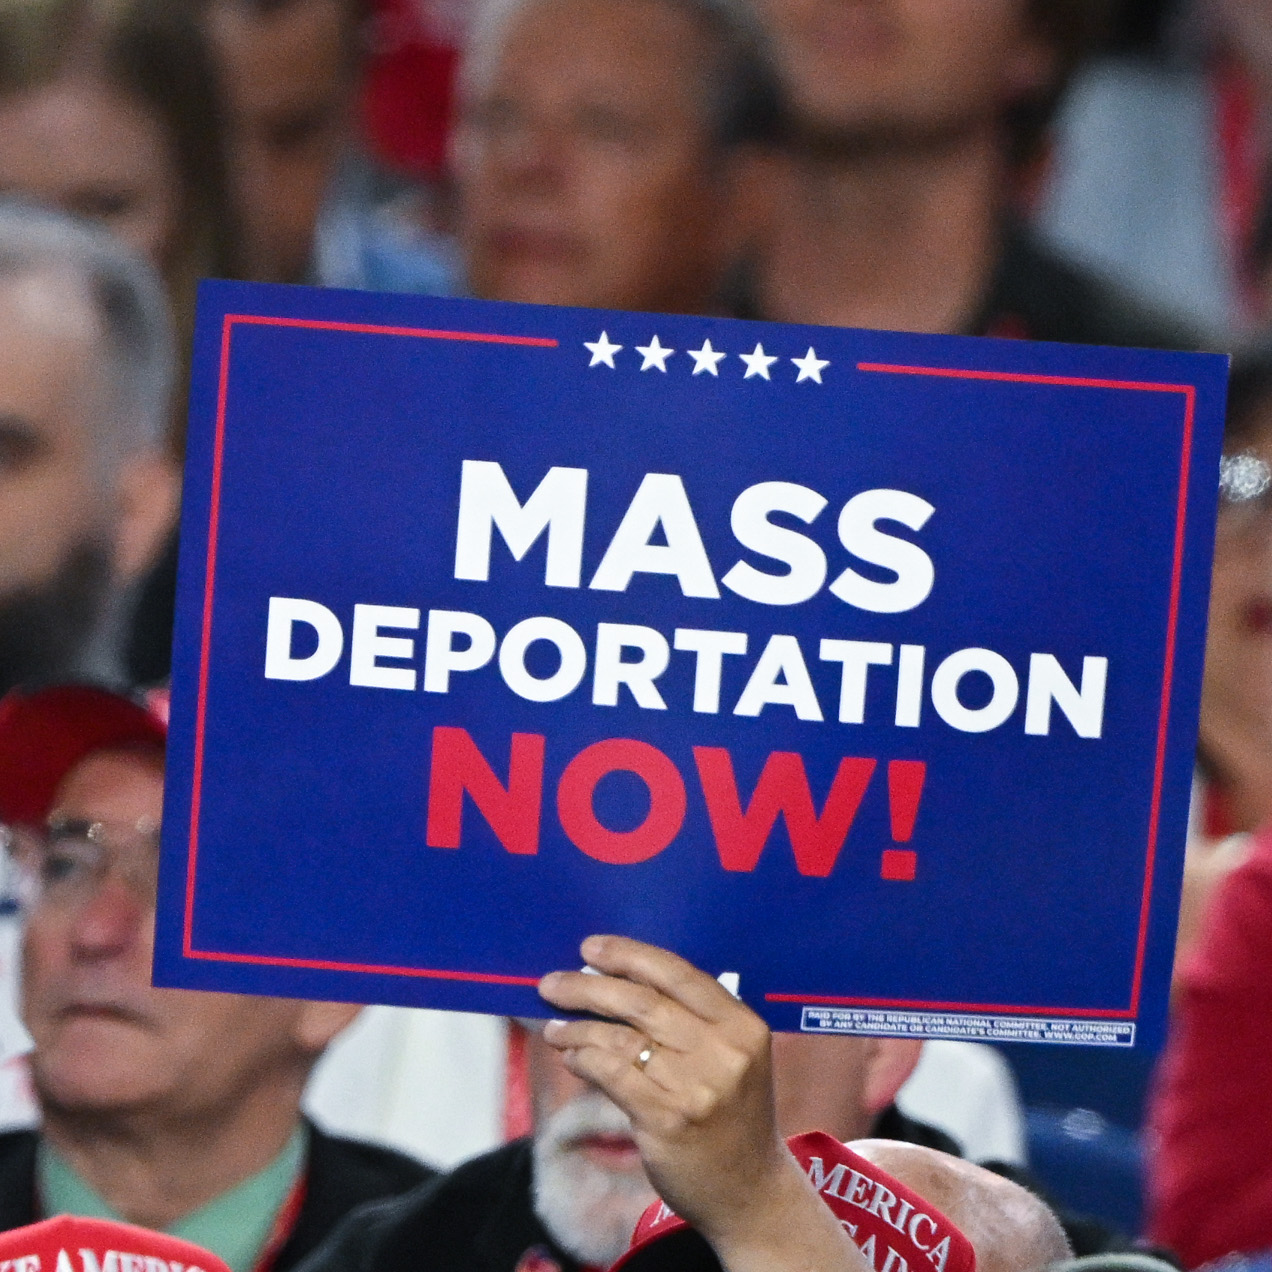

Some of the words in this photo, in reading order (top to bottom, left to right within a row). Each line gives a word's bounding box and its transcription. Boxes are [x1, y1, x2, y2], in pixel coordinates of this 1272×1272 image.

[453, 459, 935, 614] MASS
[263, 597, 1108, 740] DEPORTATION
[424, 726, 927, 882] NOW!
[807, 1011, 830, 1020] PAID
[832, 1013, 851, 1021] FOR
[867, 1014, 885, 1022] THE
[886, 1015, 944, 1026] REPUBLICAN
[945, 1017, 991, 1028] NATIONAL
[1051, 1022, 1070, 1032] NOT
[1072, 1023, 1130, 1035] AUTHORIZED
[819, 1019, 832, 1028] BY
[833, 1020, 853, 1029] ANY
[854, 1021, 908, 1033] CANDIDATE
[909, 1025, 924, 1033] OR
